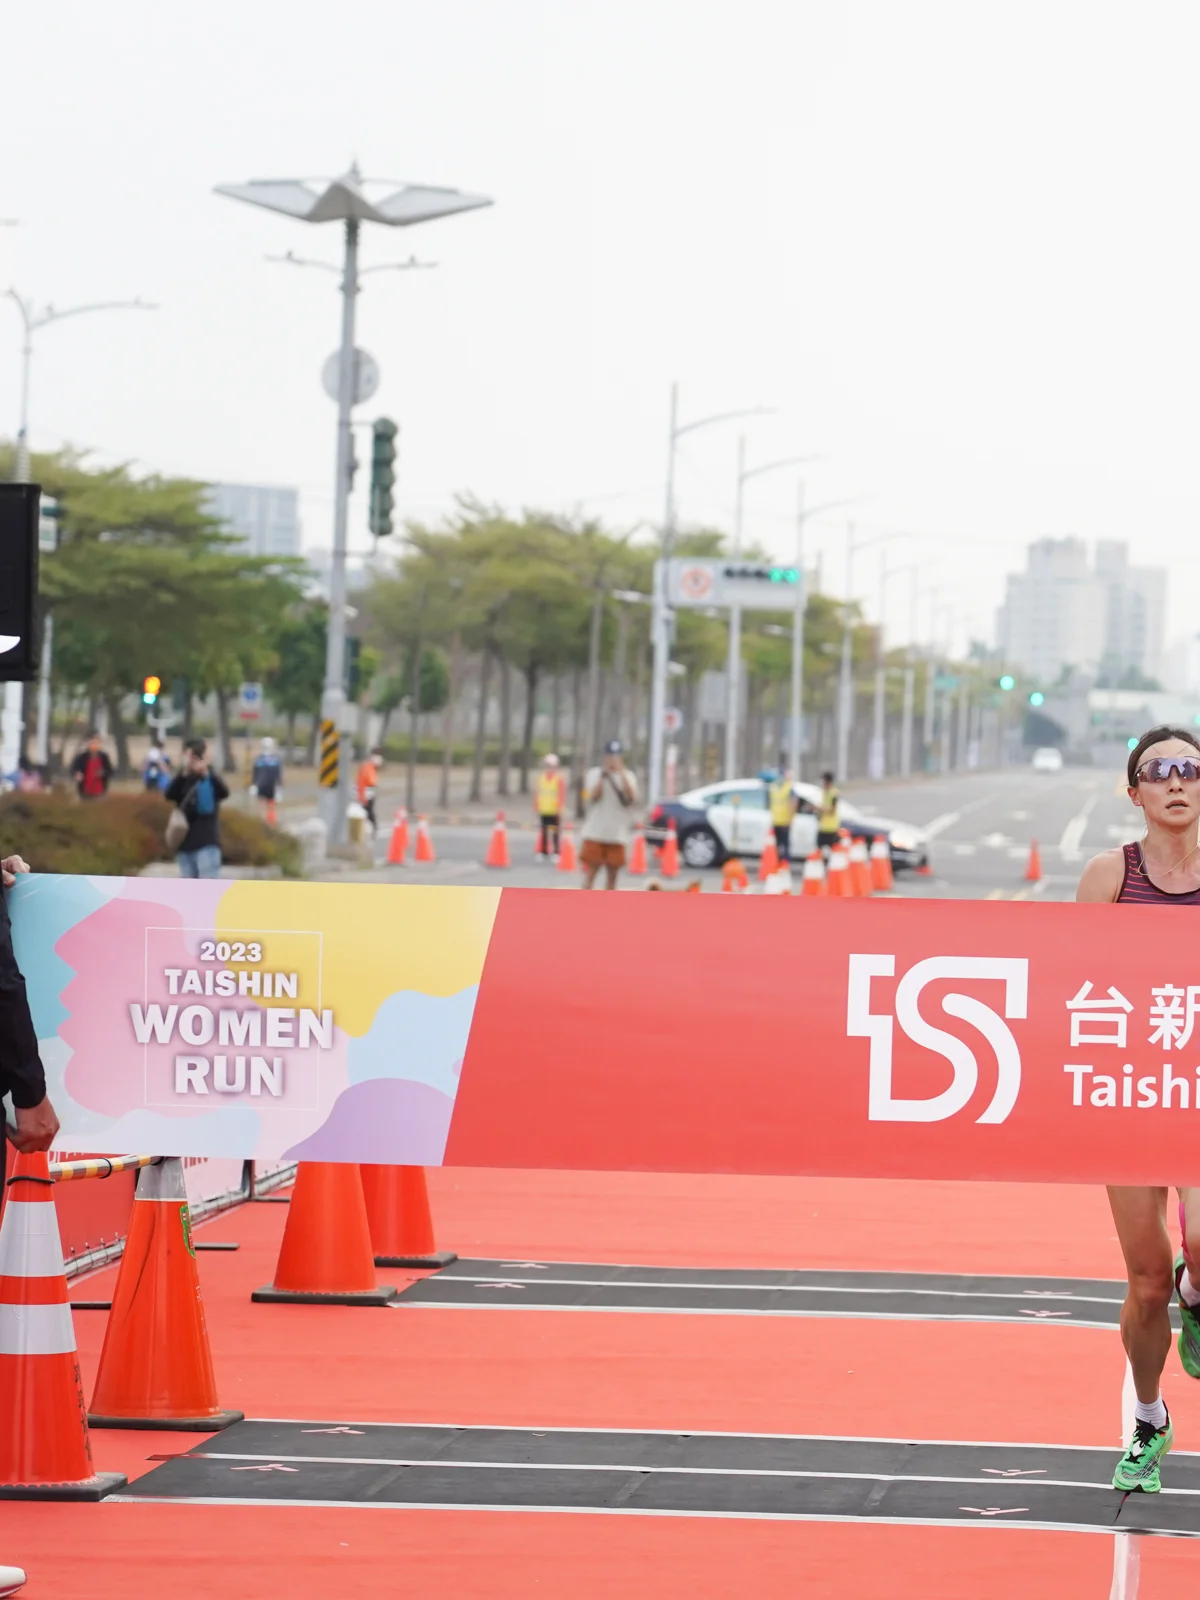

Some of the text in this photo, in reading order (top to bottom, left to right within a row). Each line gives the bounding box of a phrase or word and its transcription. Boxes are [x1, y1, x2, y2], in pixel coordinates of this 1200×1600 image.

[200, 941, 262, 962] 2023
[165, 969, 297, 998] TAISHIN
[129, 1003, 334, 1049] WOMEN
[175, 1055, 283, 1097] RUN
